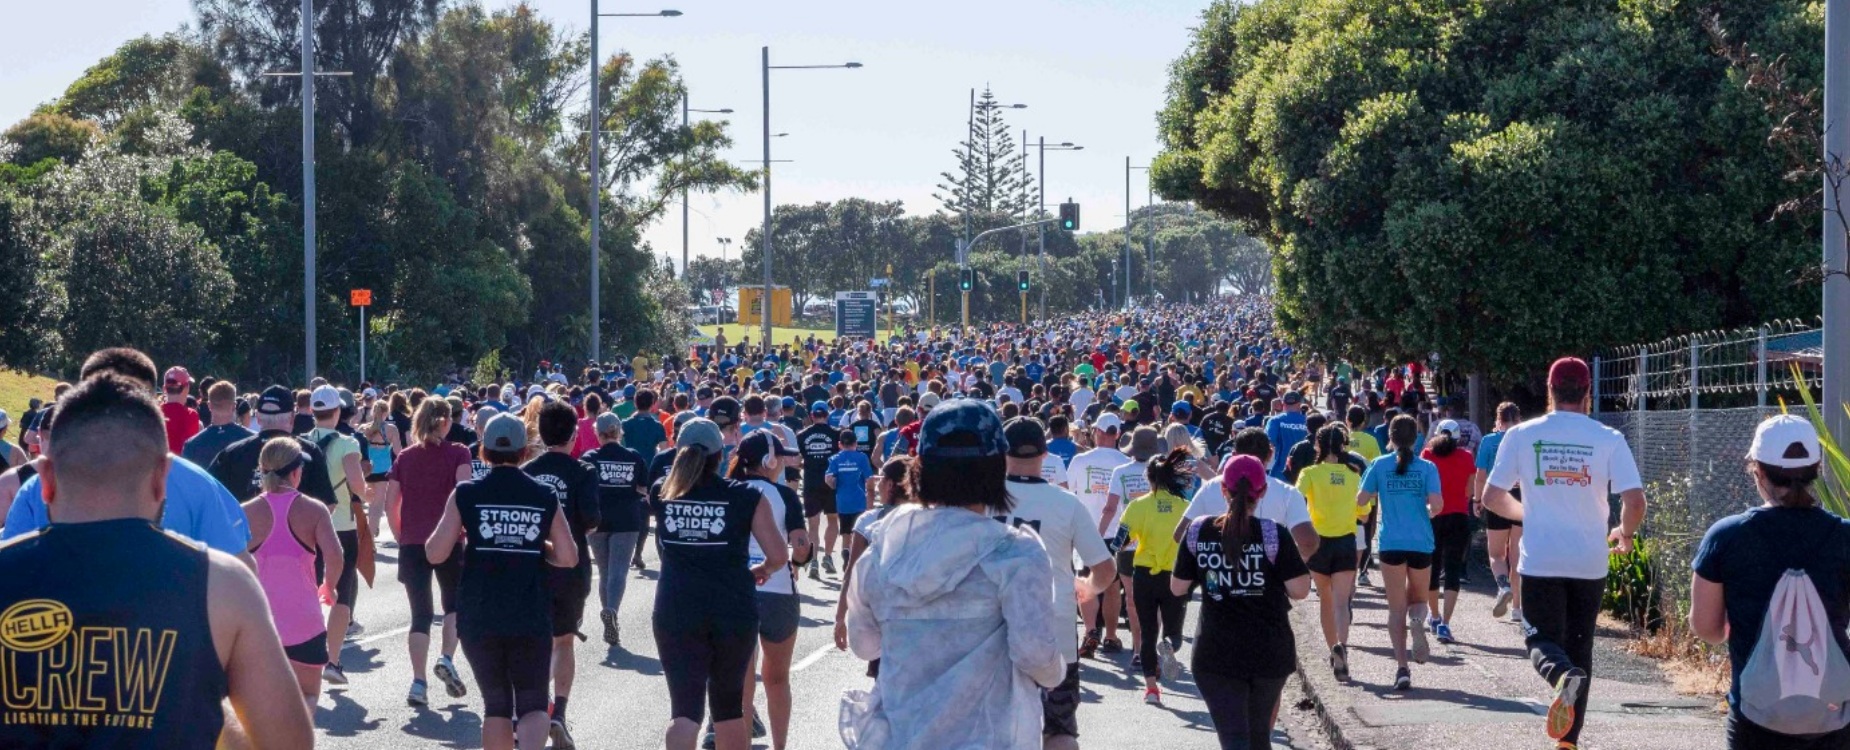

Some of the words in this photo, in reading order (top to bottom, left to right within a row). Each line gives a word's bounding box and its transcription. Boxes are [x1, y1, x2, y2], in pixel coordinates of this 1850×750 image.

[600, 463, 634, 472] STRONG
[1387, 479, 1423, 489] FITNESS
[480, 509, 541, 524] STRONG
[664, 503, 726, 517] STRONG
[493, 522, 528, 535] SIDE
[676, 516, 711, 529] SIDE
[1197, 542, 1218, 552] BUT
[1242, 543, 1264, 553] CAN
[1197, 553, 1264, 570] COUNT
[1237, 571, 1265, 588] US
[5, 611, 70, 636] HELLA
[2, 626, 178, 714] CREW
[4, 712, 68, 726] LIGHTING
[73, 713, 98, 726] THE
[104, 714, 155, 730] FUTURE
